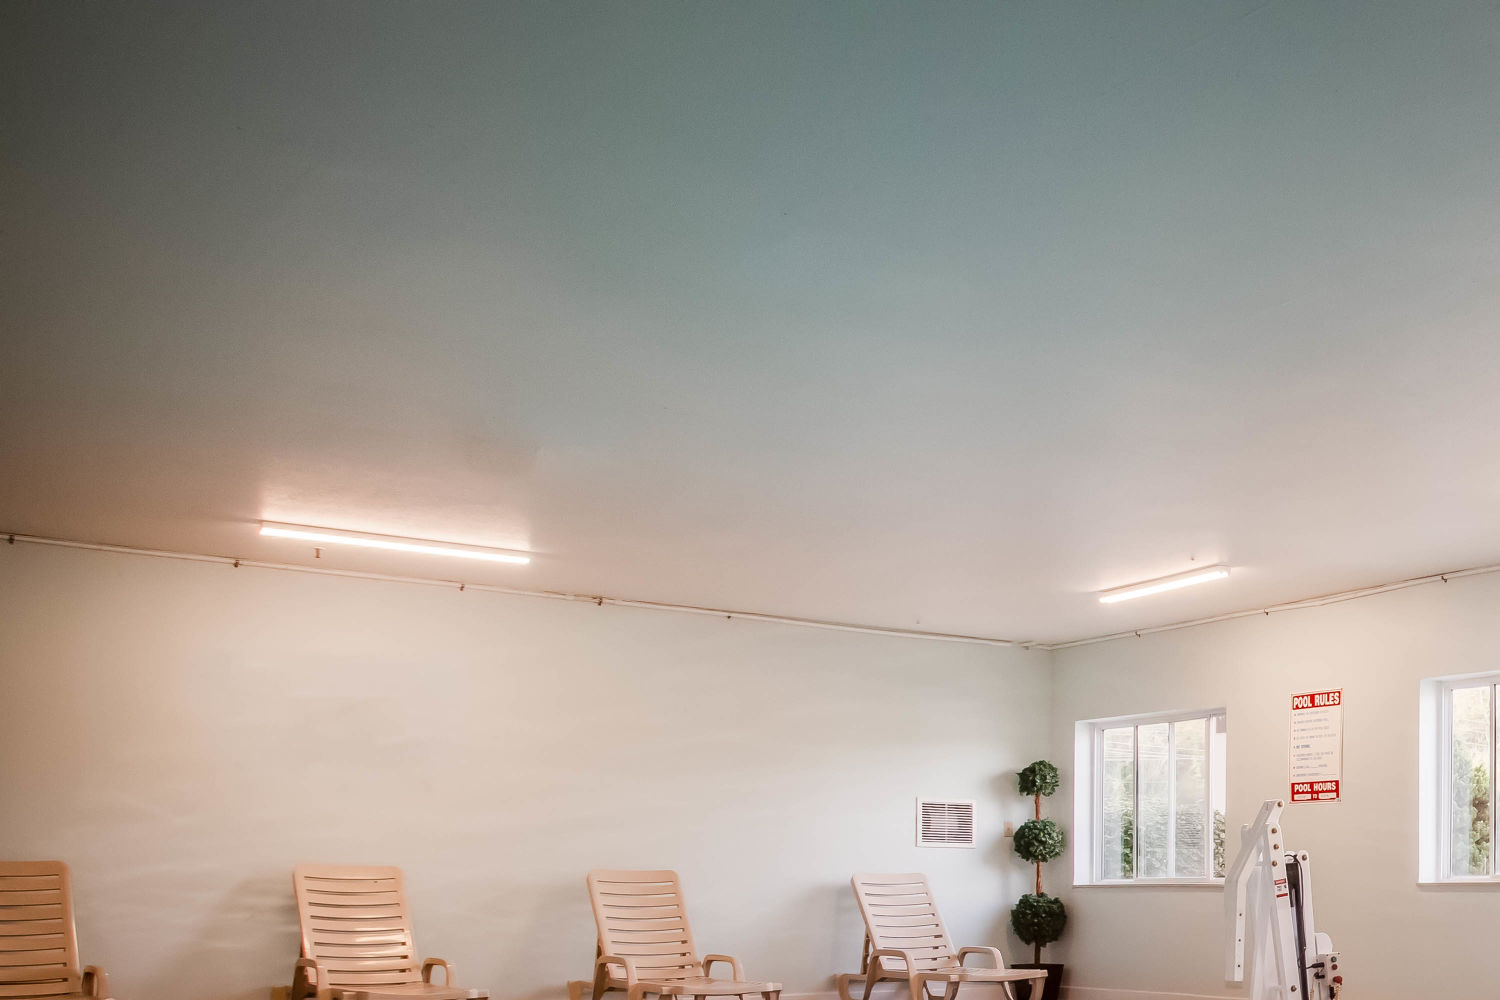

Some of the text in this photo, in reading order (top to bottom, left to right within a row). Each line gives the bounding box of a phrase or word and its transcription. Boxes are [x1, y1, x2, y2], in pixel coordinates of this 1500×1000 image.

[1293, 692, 1340, 709] POOL RULES
[1294, 782, 1336, 792] POOL HOURS
